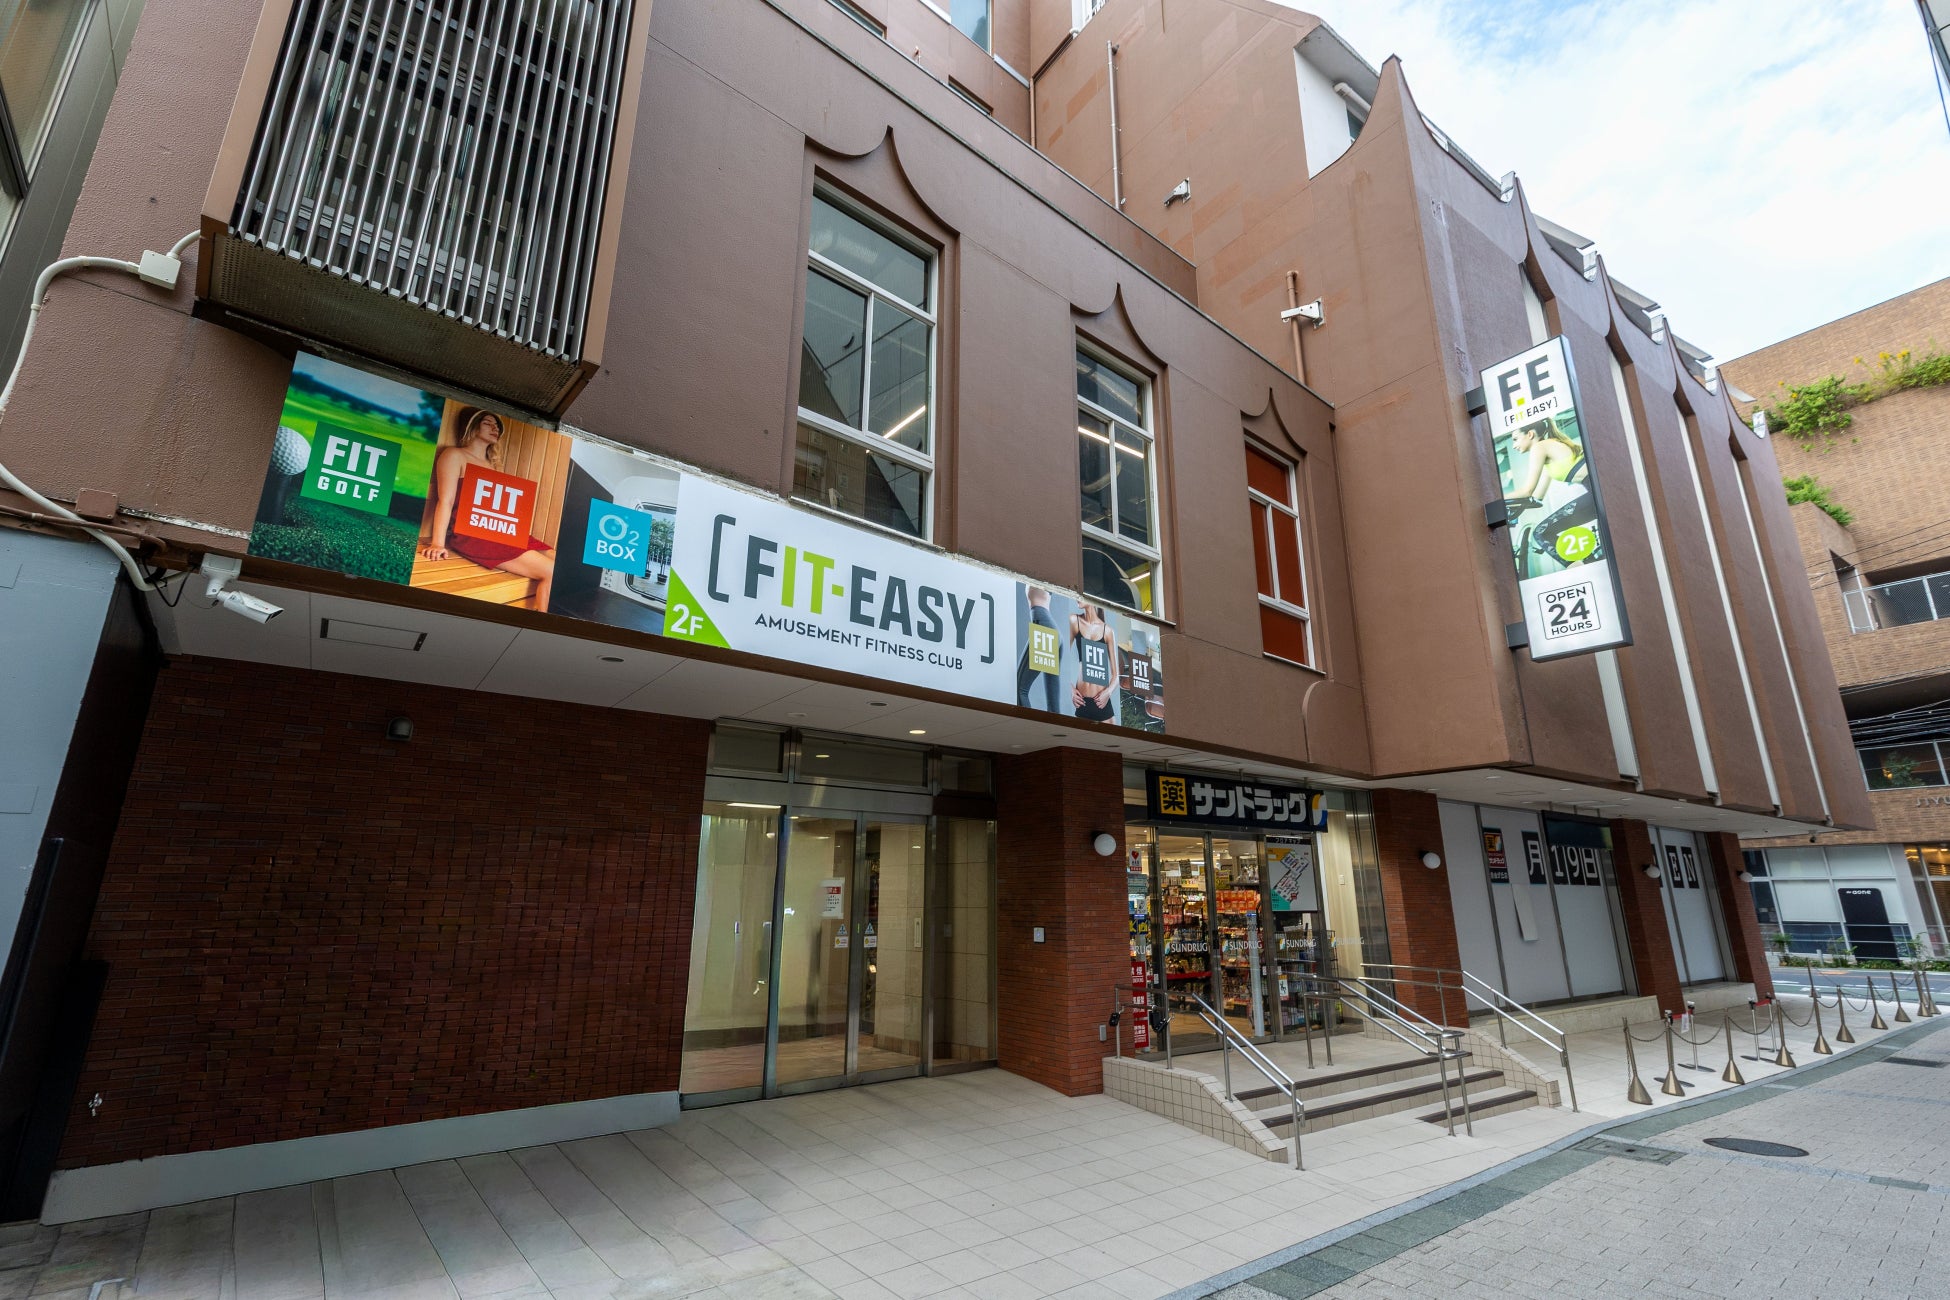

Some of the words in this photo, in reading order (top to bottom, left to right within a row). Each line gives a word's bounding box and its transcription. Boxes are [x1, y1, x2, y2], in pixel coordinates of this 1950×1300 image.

[322, 434, 388, 477] FIT
[317, 475, 380, 502] GOLF
[473, 478, 524, 515] FIT
[469, 513, 517, 537] SAUNA
[596, 539, 636, 562] BOX
[1563, 534, 1590, 556] 2F
[1545, 586, 1587, 604] OPEN
[670, 603, 704, 636] 2F
[1548, 597, 1590, 627] 24
[1551, 620, 1593, 636] HOURS
[755, 612, 861, 648] AMUSEMENT
[865, 637, 924, 662] FITNESS
[928, 652, 963, 670] CLUB
[1033, 630, 1055, 653] FIT
[1034, 655, 1056, 668] CHAIR
[1085, 644, 1105, 666] FIT
[1086, 668, 1106, 680] SHAPE
[1132, 658, 1149, 678] FIT
[1133, 679, 1151, 691] LOUNGE
[1161, 779, 1185, 812] 薬
[1191, 782, 1307, 823] サンドラッグ
[1171, 940, 1208, 954] SUNDRUG
[1228, 939, 1263, 951] SUNDRUG
[1286, 937, 1317, 949] SUNDRUG
